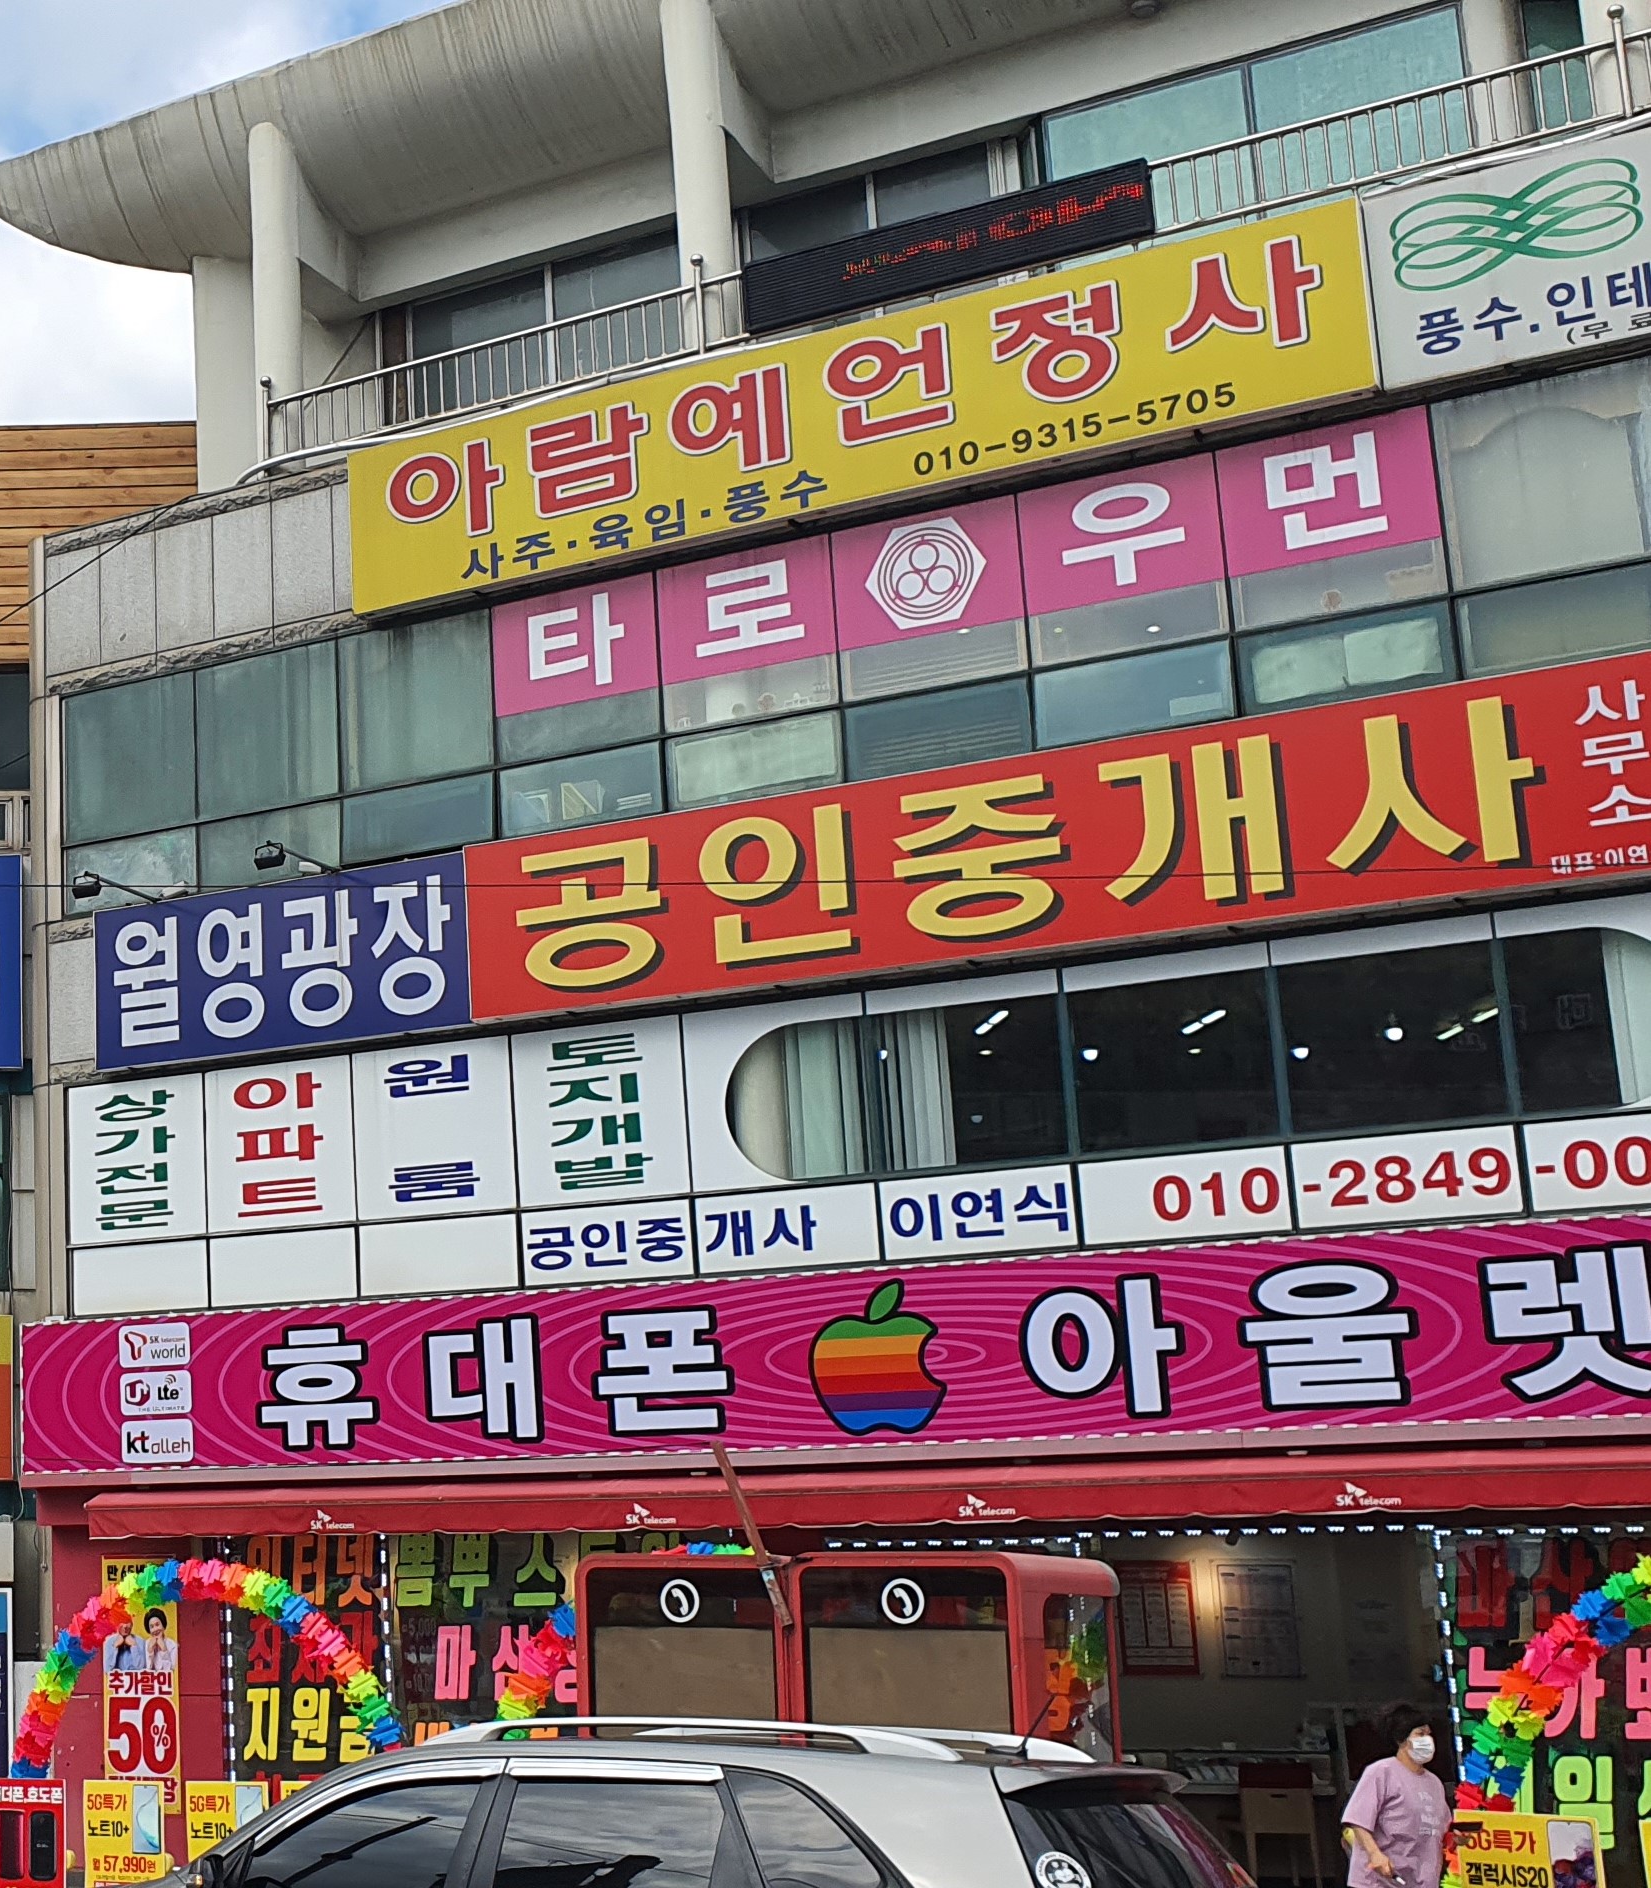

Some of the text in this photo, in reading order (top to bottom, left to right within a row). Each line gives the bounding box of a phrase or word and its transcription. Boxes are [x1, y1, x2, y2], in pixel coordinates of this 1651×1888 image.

[385, 234, 1322, 536] 아람예언정사
[914, 382, 1237, 476] 010-9315-5705
[113, 679, 1651, 1050] 월영광장 공인중개사 사무소
[546, 1032, 652, 1191] 토지개발
[383, 1053, 480, 1204] 원룸
[232, 1071, 323, 1218] 아파트
[94, 1089, 176, 1231] 상가전문
[527, 1203, 818, 1272] 공인중개사
[890, 1180, 1073, 1243] 이연식
[149, 1336, 160, 1344] SK
[150, 1344, 186, 1359] world
[256, 1242, 1651, 1452] 휴대폰 아울렛
[958, 1505, 1016, 1517] SK telecom
[1336, 1494, 1402, 1506] SK telecom
[310, 1519, 355, 1530] SK telecom
[626, 1513, 677, 1525] SK telecom
[108, 1670, 173, 1696] 추가할인
[87, 1793, 127, 1812] 5G특가
[189, 1795, 231, 1814] 5G특가
[88, 1820, 130, 1838] 노트10+
[1465, 1860, 1549, 1888] 갤럭시S20
